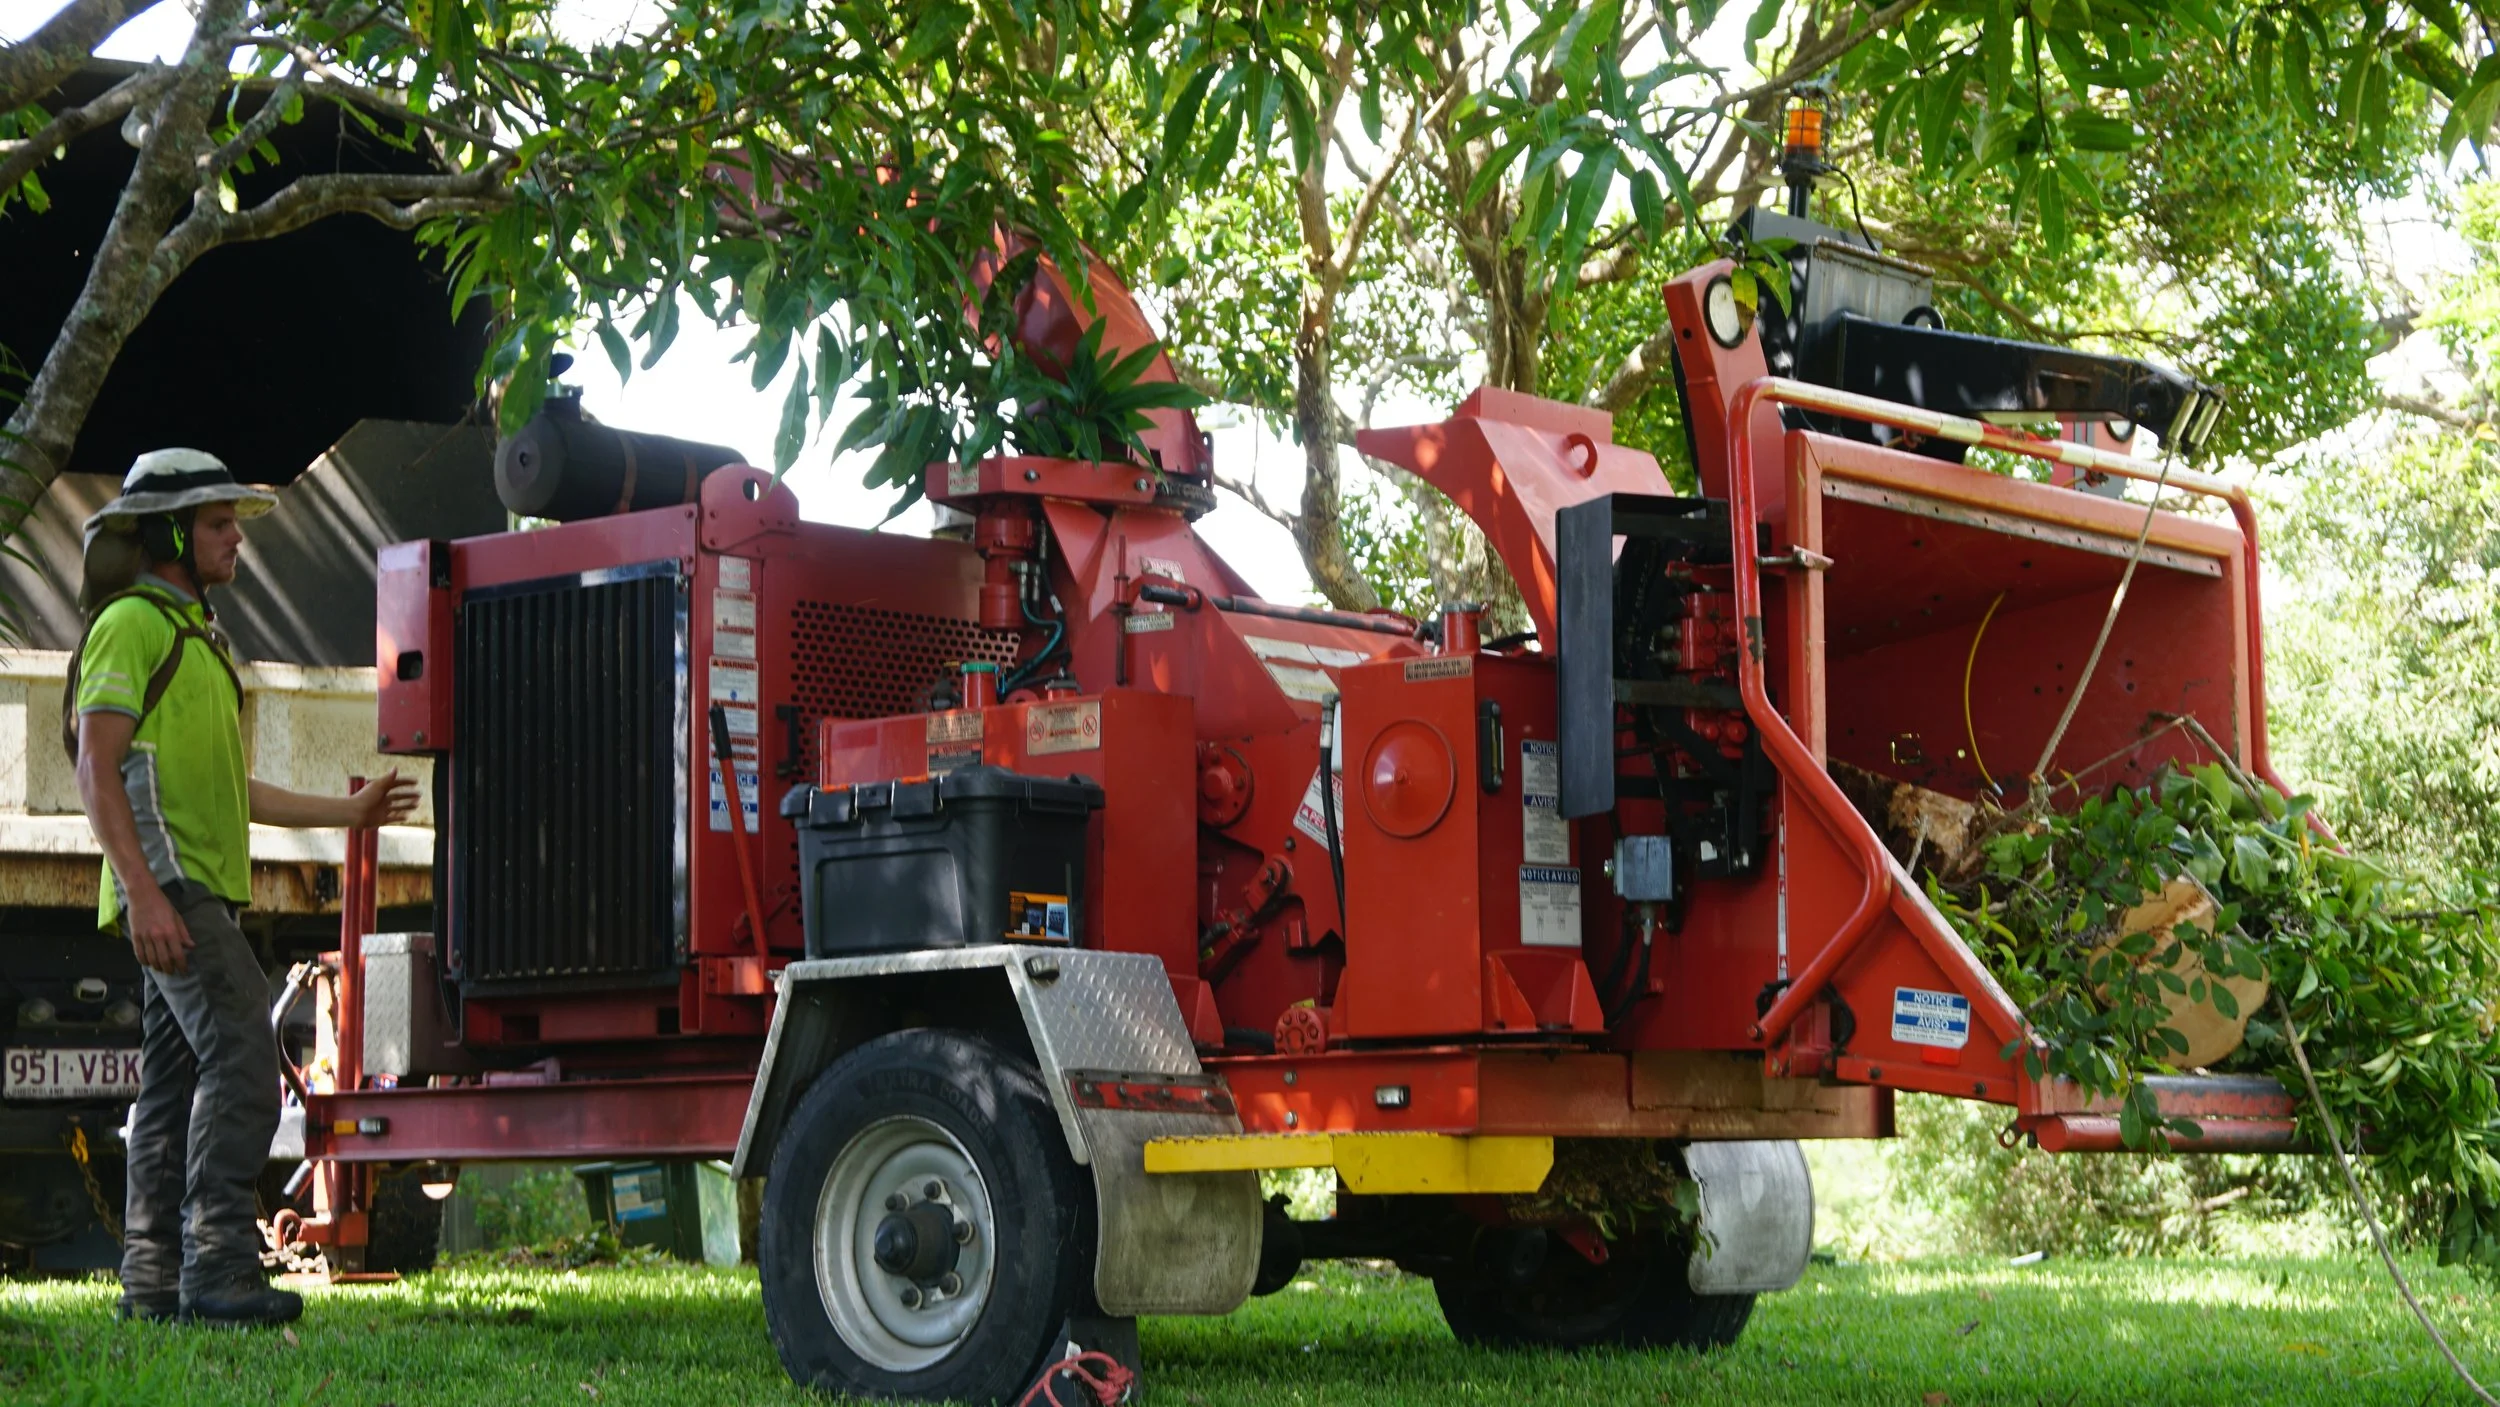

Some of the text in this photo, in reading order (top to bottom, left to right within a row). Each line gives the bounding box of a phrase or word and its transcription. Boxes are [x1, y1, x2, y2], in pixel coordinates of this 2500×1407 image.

[721, 659, 755, 670] WARNING
[716, 772, 750, 785] NICE
[1521, 868, 1578, 882] NOTICE AVISO
[1914, 992, 1952, 1006] NOTICE
[1917, 1016, 1949, 1030] AVISO
[10, 1053, 140, 1085] 951 VBK
